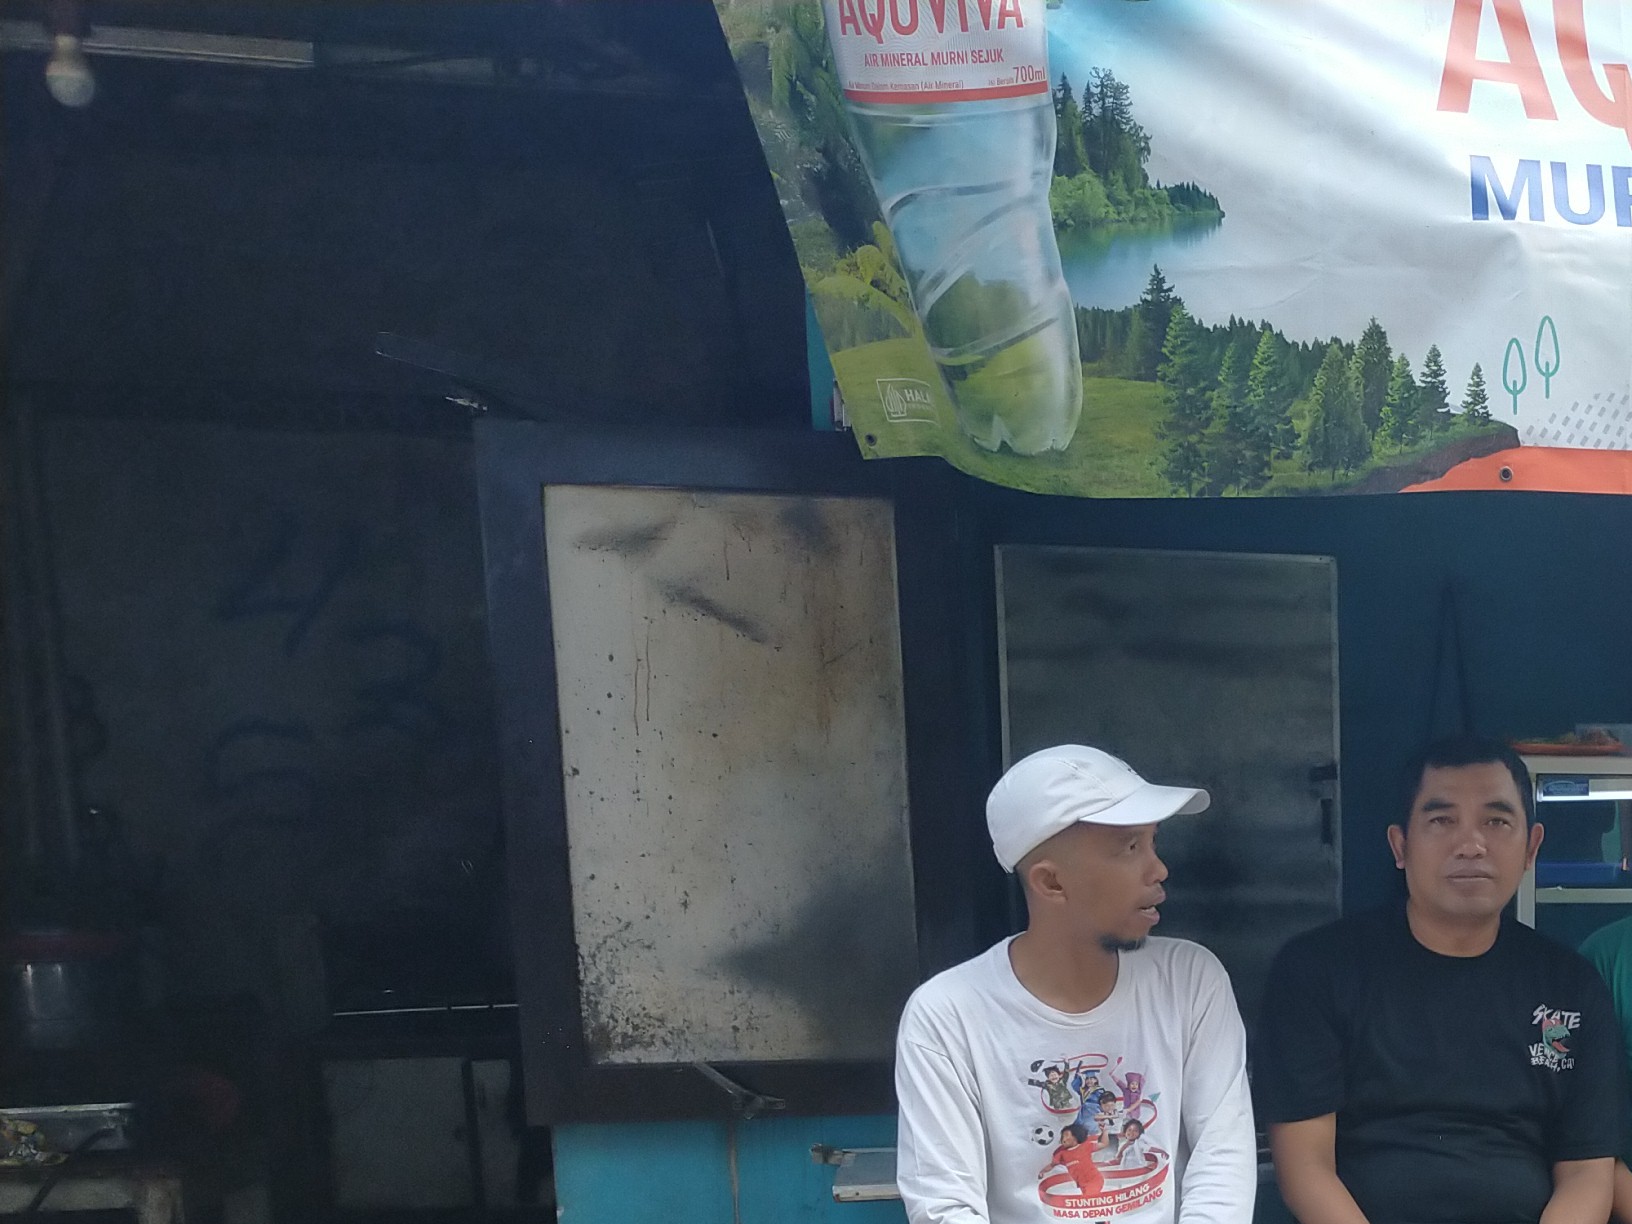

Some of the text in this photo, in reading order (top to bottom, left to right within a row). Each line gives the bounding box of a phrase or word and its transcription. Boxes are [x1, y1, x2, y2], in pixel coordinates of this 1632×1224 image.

[838, 0, 1024, 45] AQUVIVA
[864, 48, 1004, 67] AIR MINERAL MURNI SEJUK
[1012, 64, 1046, 84] 700ml
[1531, 1004, 1581, 1029] SKATE
[1065, 1183, 1150, 1207] STUNTING HILANG
[1053, 1209, 1080, 1218] MASA
[1082, 1206, 1114, 1218] DEPAN
